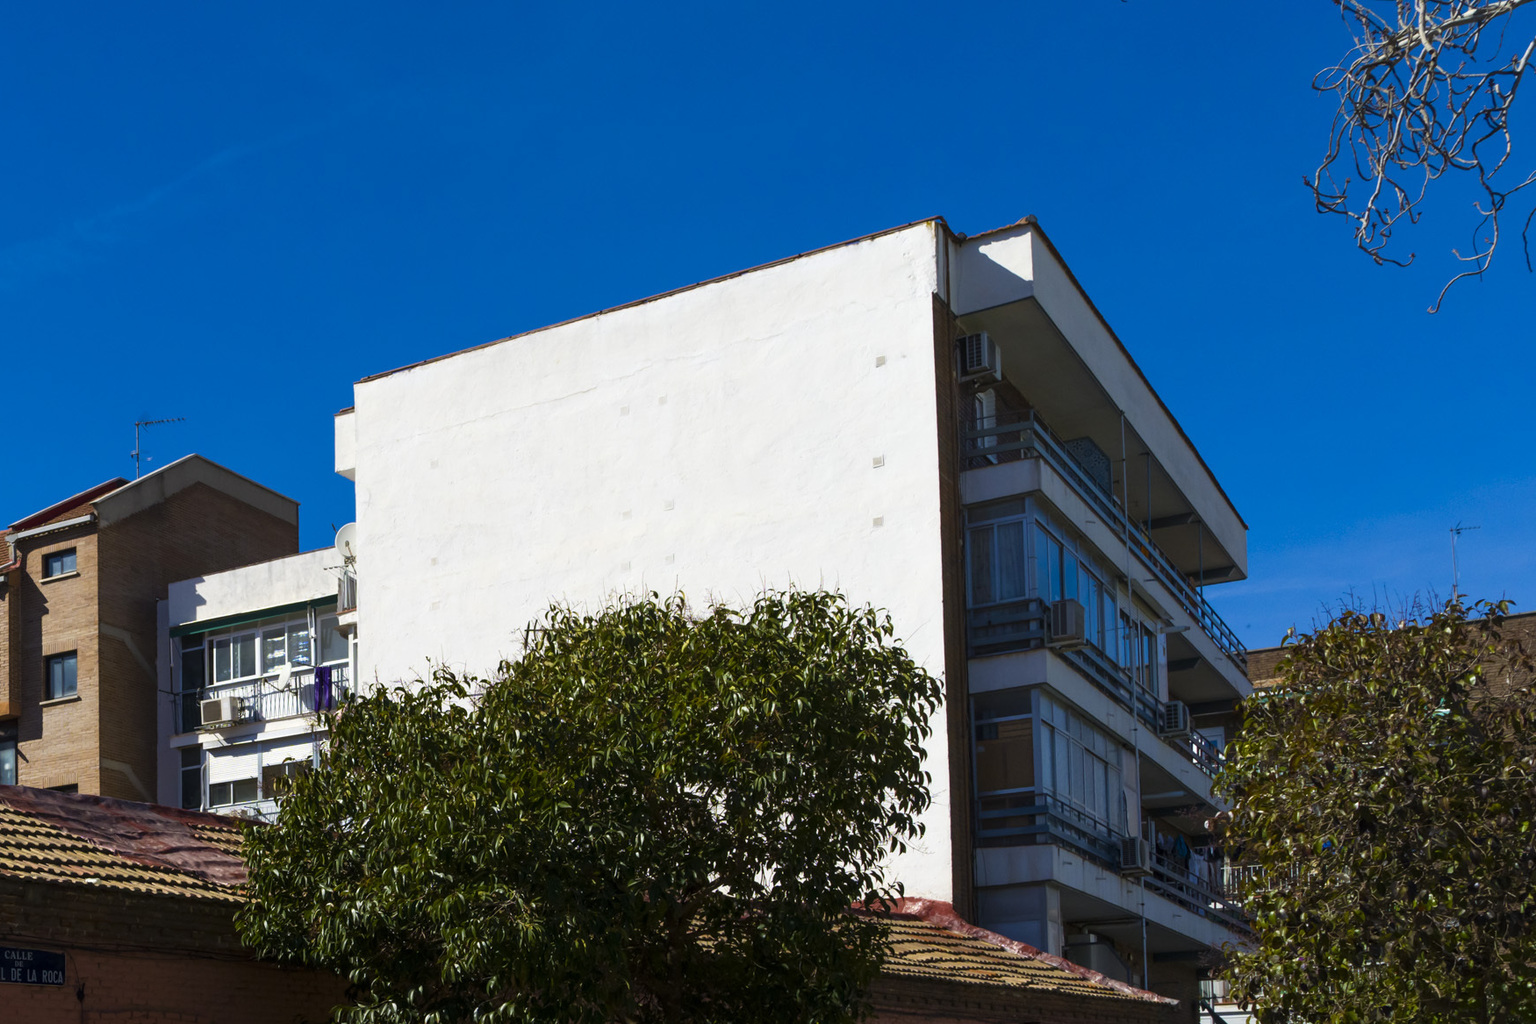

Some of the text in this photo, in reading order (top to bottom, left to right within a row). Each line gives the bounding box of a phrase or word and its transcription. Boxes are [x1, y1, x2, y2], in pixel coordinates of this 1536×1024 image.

[4, 950, 34, 961] CALLE
[14, 960, 24, 968] DE
[10, 967, 23, 982] DE
[26, 968, 38, 983] LA
[42, 969, 64, 984] ROCA
